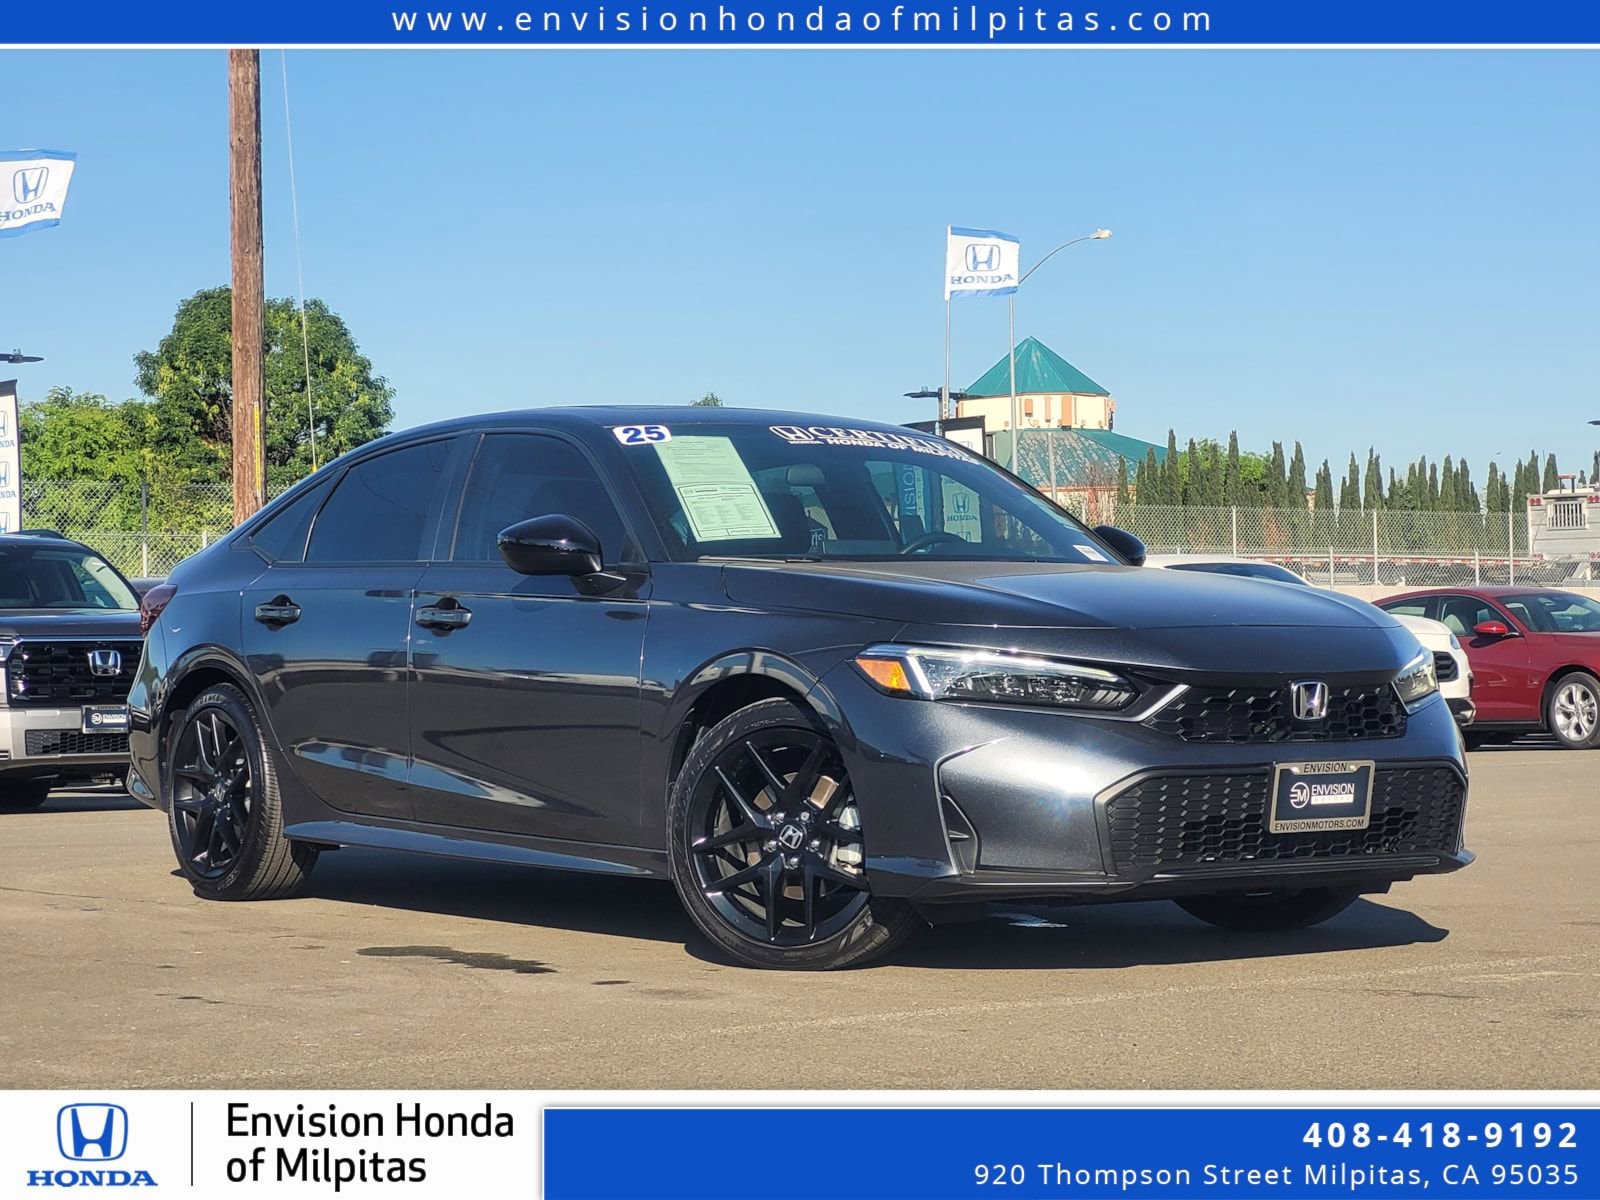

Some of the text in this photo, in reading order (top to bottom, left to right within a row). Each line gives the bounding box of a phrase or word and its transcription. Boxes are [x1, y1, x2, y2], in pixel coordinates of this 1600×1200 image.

[0, 202, 56, 220] HONDA
[950, 274, 1014, 284] HONDA
[622, 427, 666, 442] 25
[827, 438, 886, 448] HONDA
[1303, 763, 1347, 773] ENVISION
[1311, 784, 1354, 795] ENVISION
[1275, 820, 1364, 831] ENVISIONMOTORS.COM
